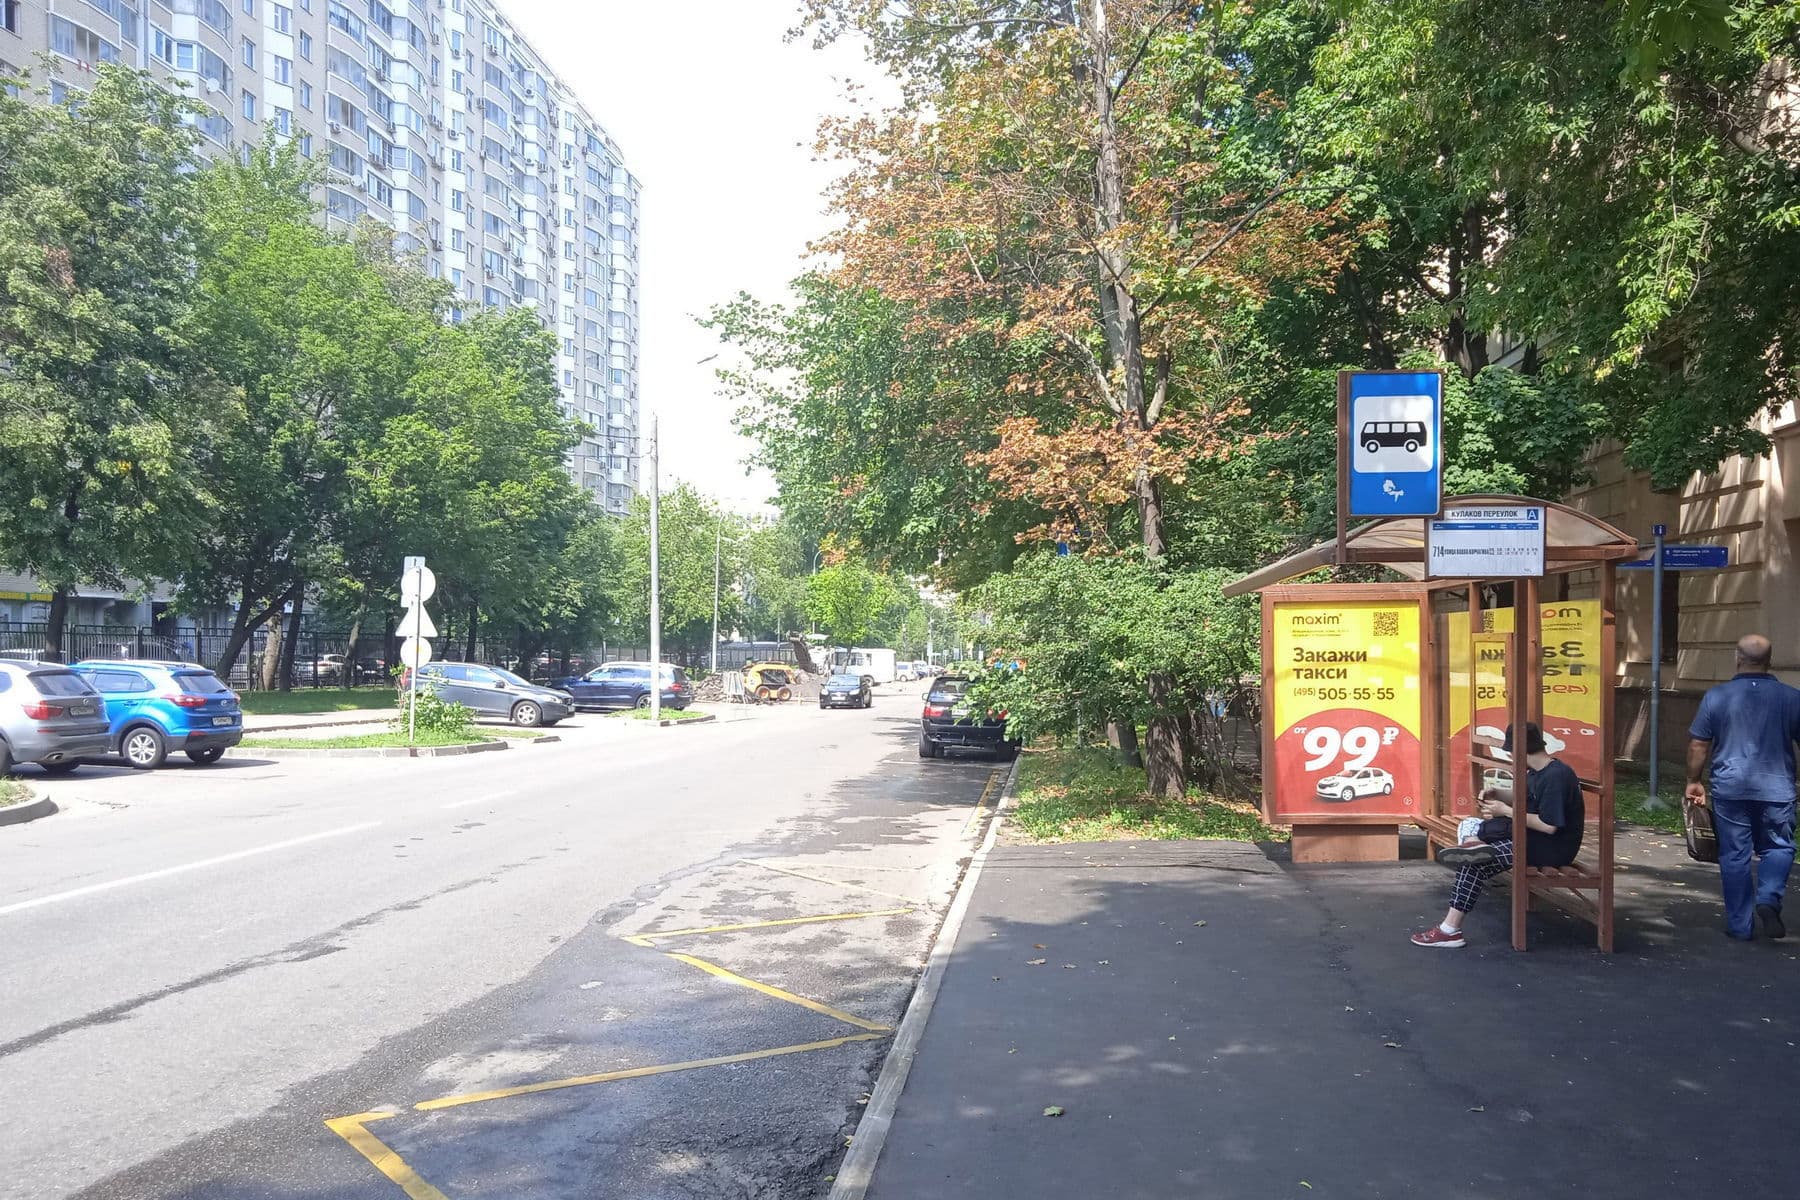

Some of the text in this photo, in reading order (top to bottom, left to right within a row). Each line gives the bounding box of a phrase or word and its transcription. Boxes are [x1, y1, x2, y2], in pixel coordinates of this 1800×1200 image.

[1451, 510, 1518, 518] КУЛАКОВ ПЕРЕУЛОК
[1433, 545, 1444, 557] 714
[1293, 647, 1367, 662] Закажи
[1293, 667, 1347, 680] такси
[1293, 687, 1316, 697] (495)
